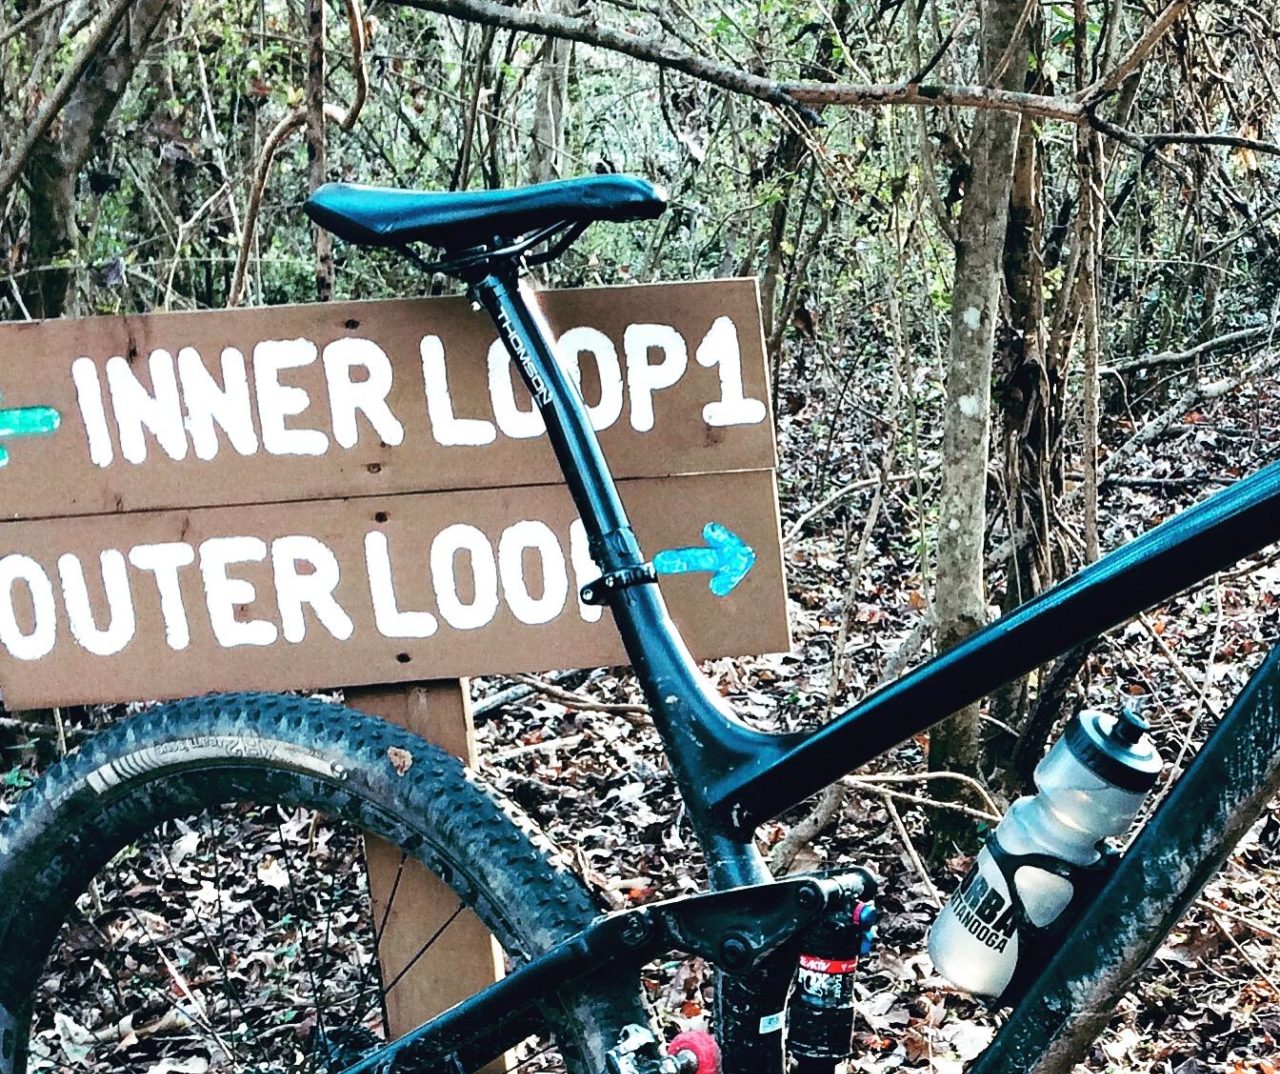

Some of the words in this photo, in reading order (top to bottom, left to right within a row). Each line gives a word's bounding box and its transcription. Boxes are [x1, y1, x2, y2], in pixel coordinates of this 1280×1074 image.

[71, 337, 404, 467] INNER
[497, 305, 553, 406] THOMSON
[0, 535, 354, 661] OUTER
